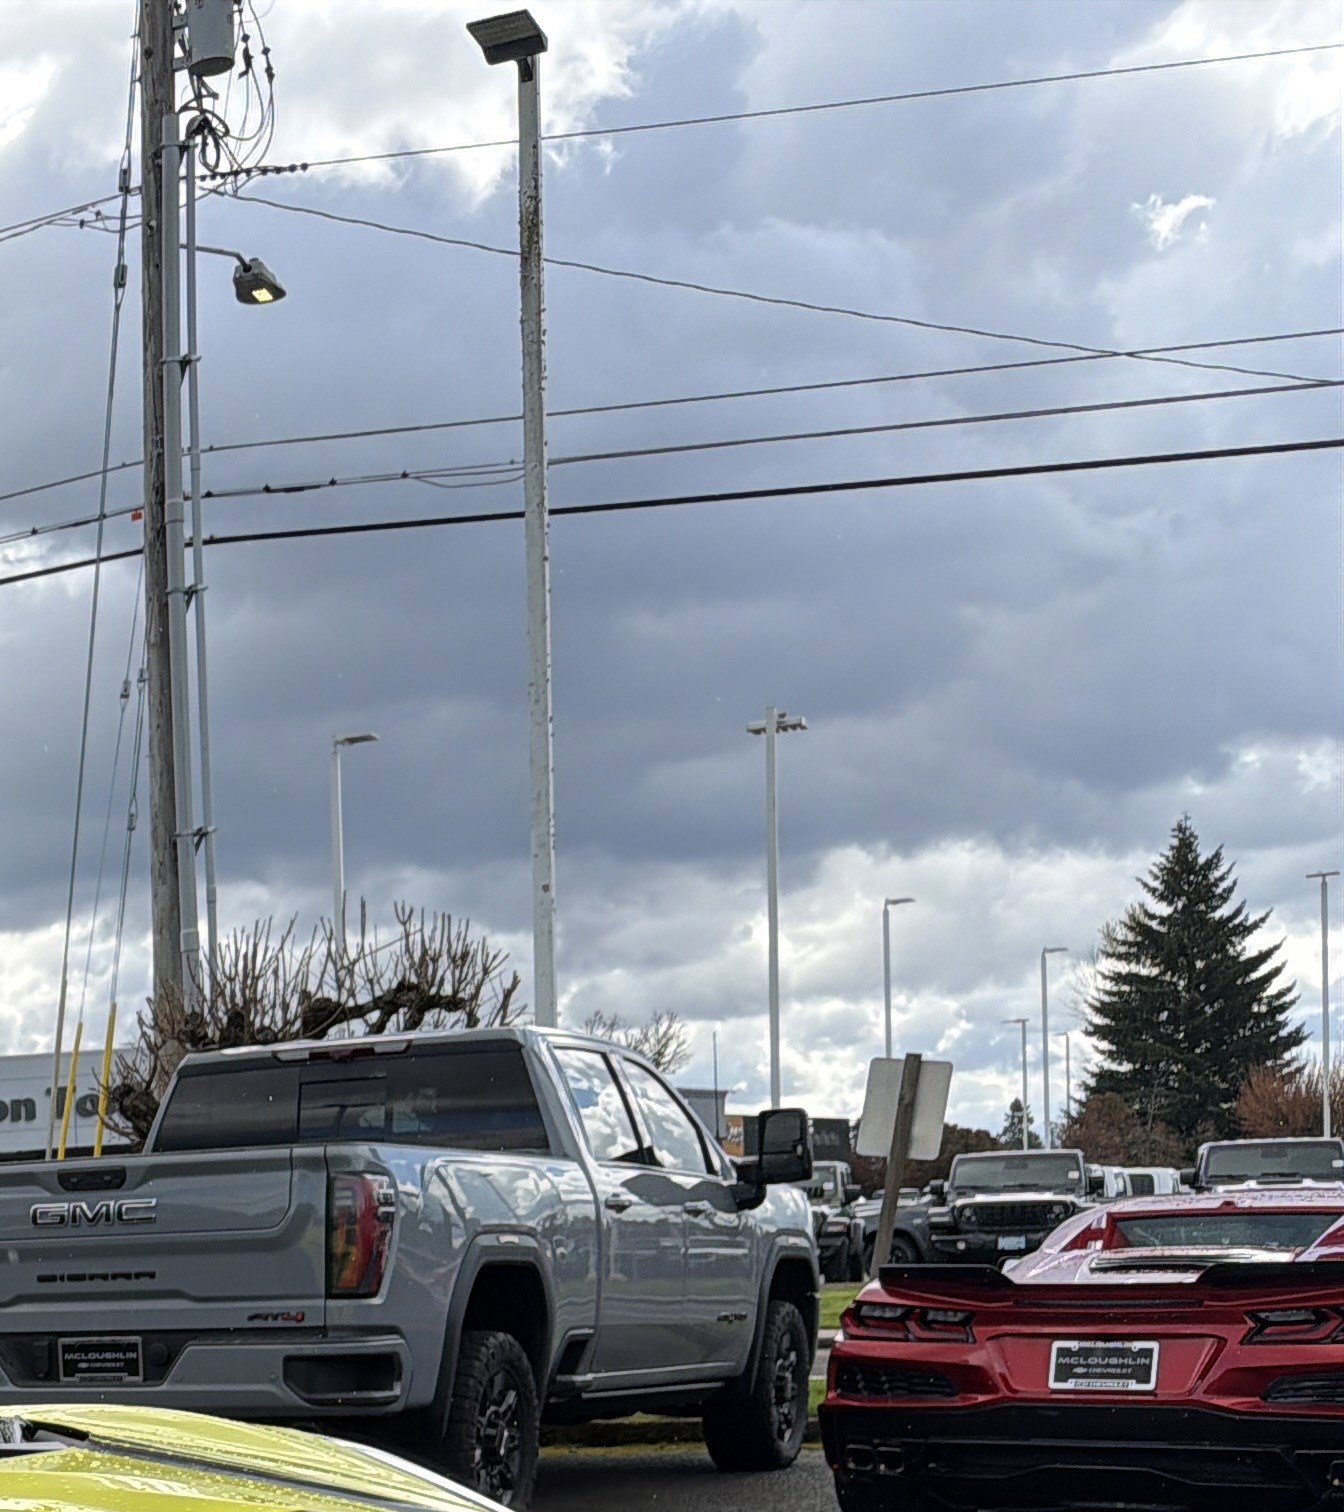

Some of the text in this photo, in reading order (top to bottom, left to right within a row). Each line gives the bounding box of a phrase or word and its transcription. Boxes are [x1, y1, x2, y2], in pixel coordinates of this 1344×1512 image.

[30, 1198, 157, 1227] GMC
[36, 1271, 156, 1282] SIERRA
[1057, 1356, 1151, 1365] MCLOUGHLIN
